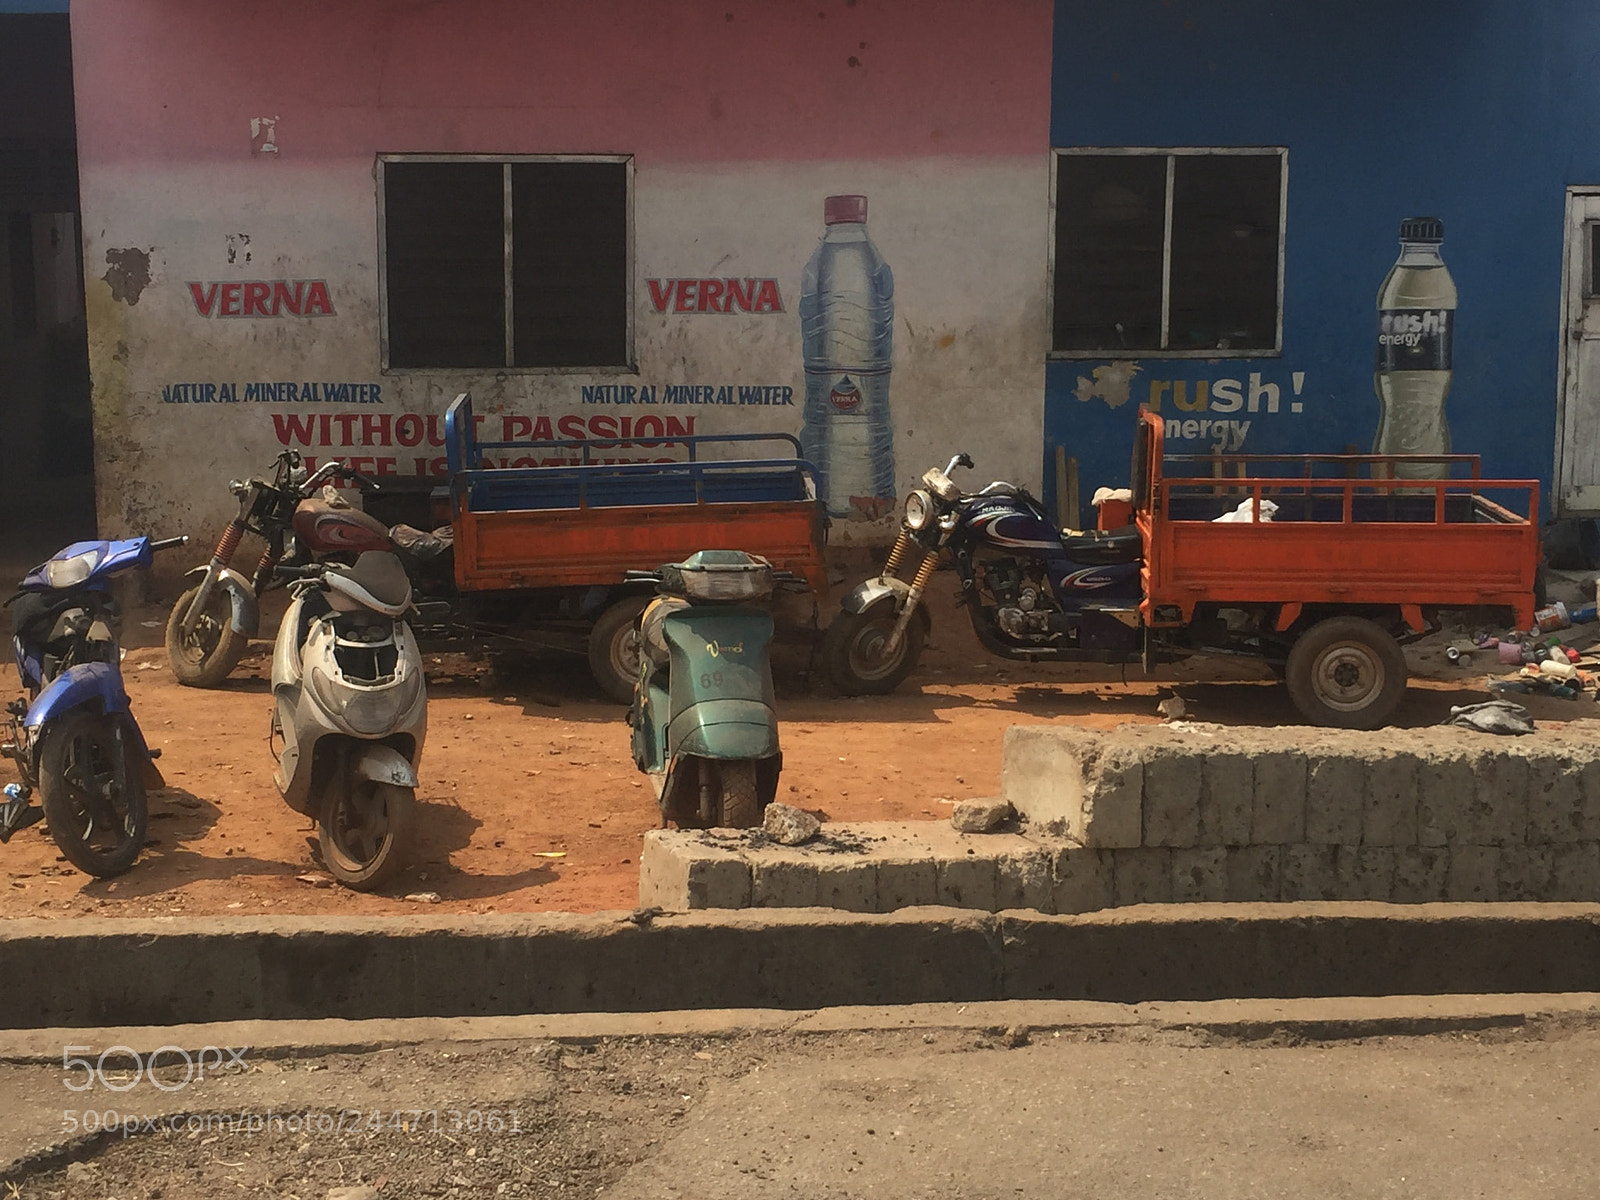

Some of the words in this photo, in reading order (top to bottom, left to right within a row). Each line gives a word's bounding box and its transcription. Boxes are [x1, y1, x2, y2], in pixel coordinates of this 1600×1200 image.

[187, 279, 336, 318] VERNA
[647, 277, 785, 314] VERNA
[1378, 333, 1421, 347] energy
[243, 382, 320, 402] MINERAL
[322, 382, 384, 404] WATER
[581, 385, 658, 404] NATURAL
[662, 385, 736, 405] MINERAL
[737, 386, 795, 406] WATER
[502, 414, 696, 449] PASSION
[1165, 418, 1252, 452] nergy
